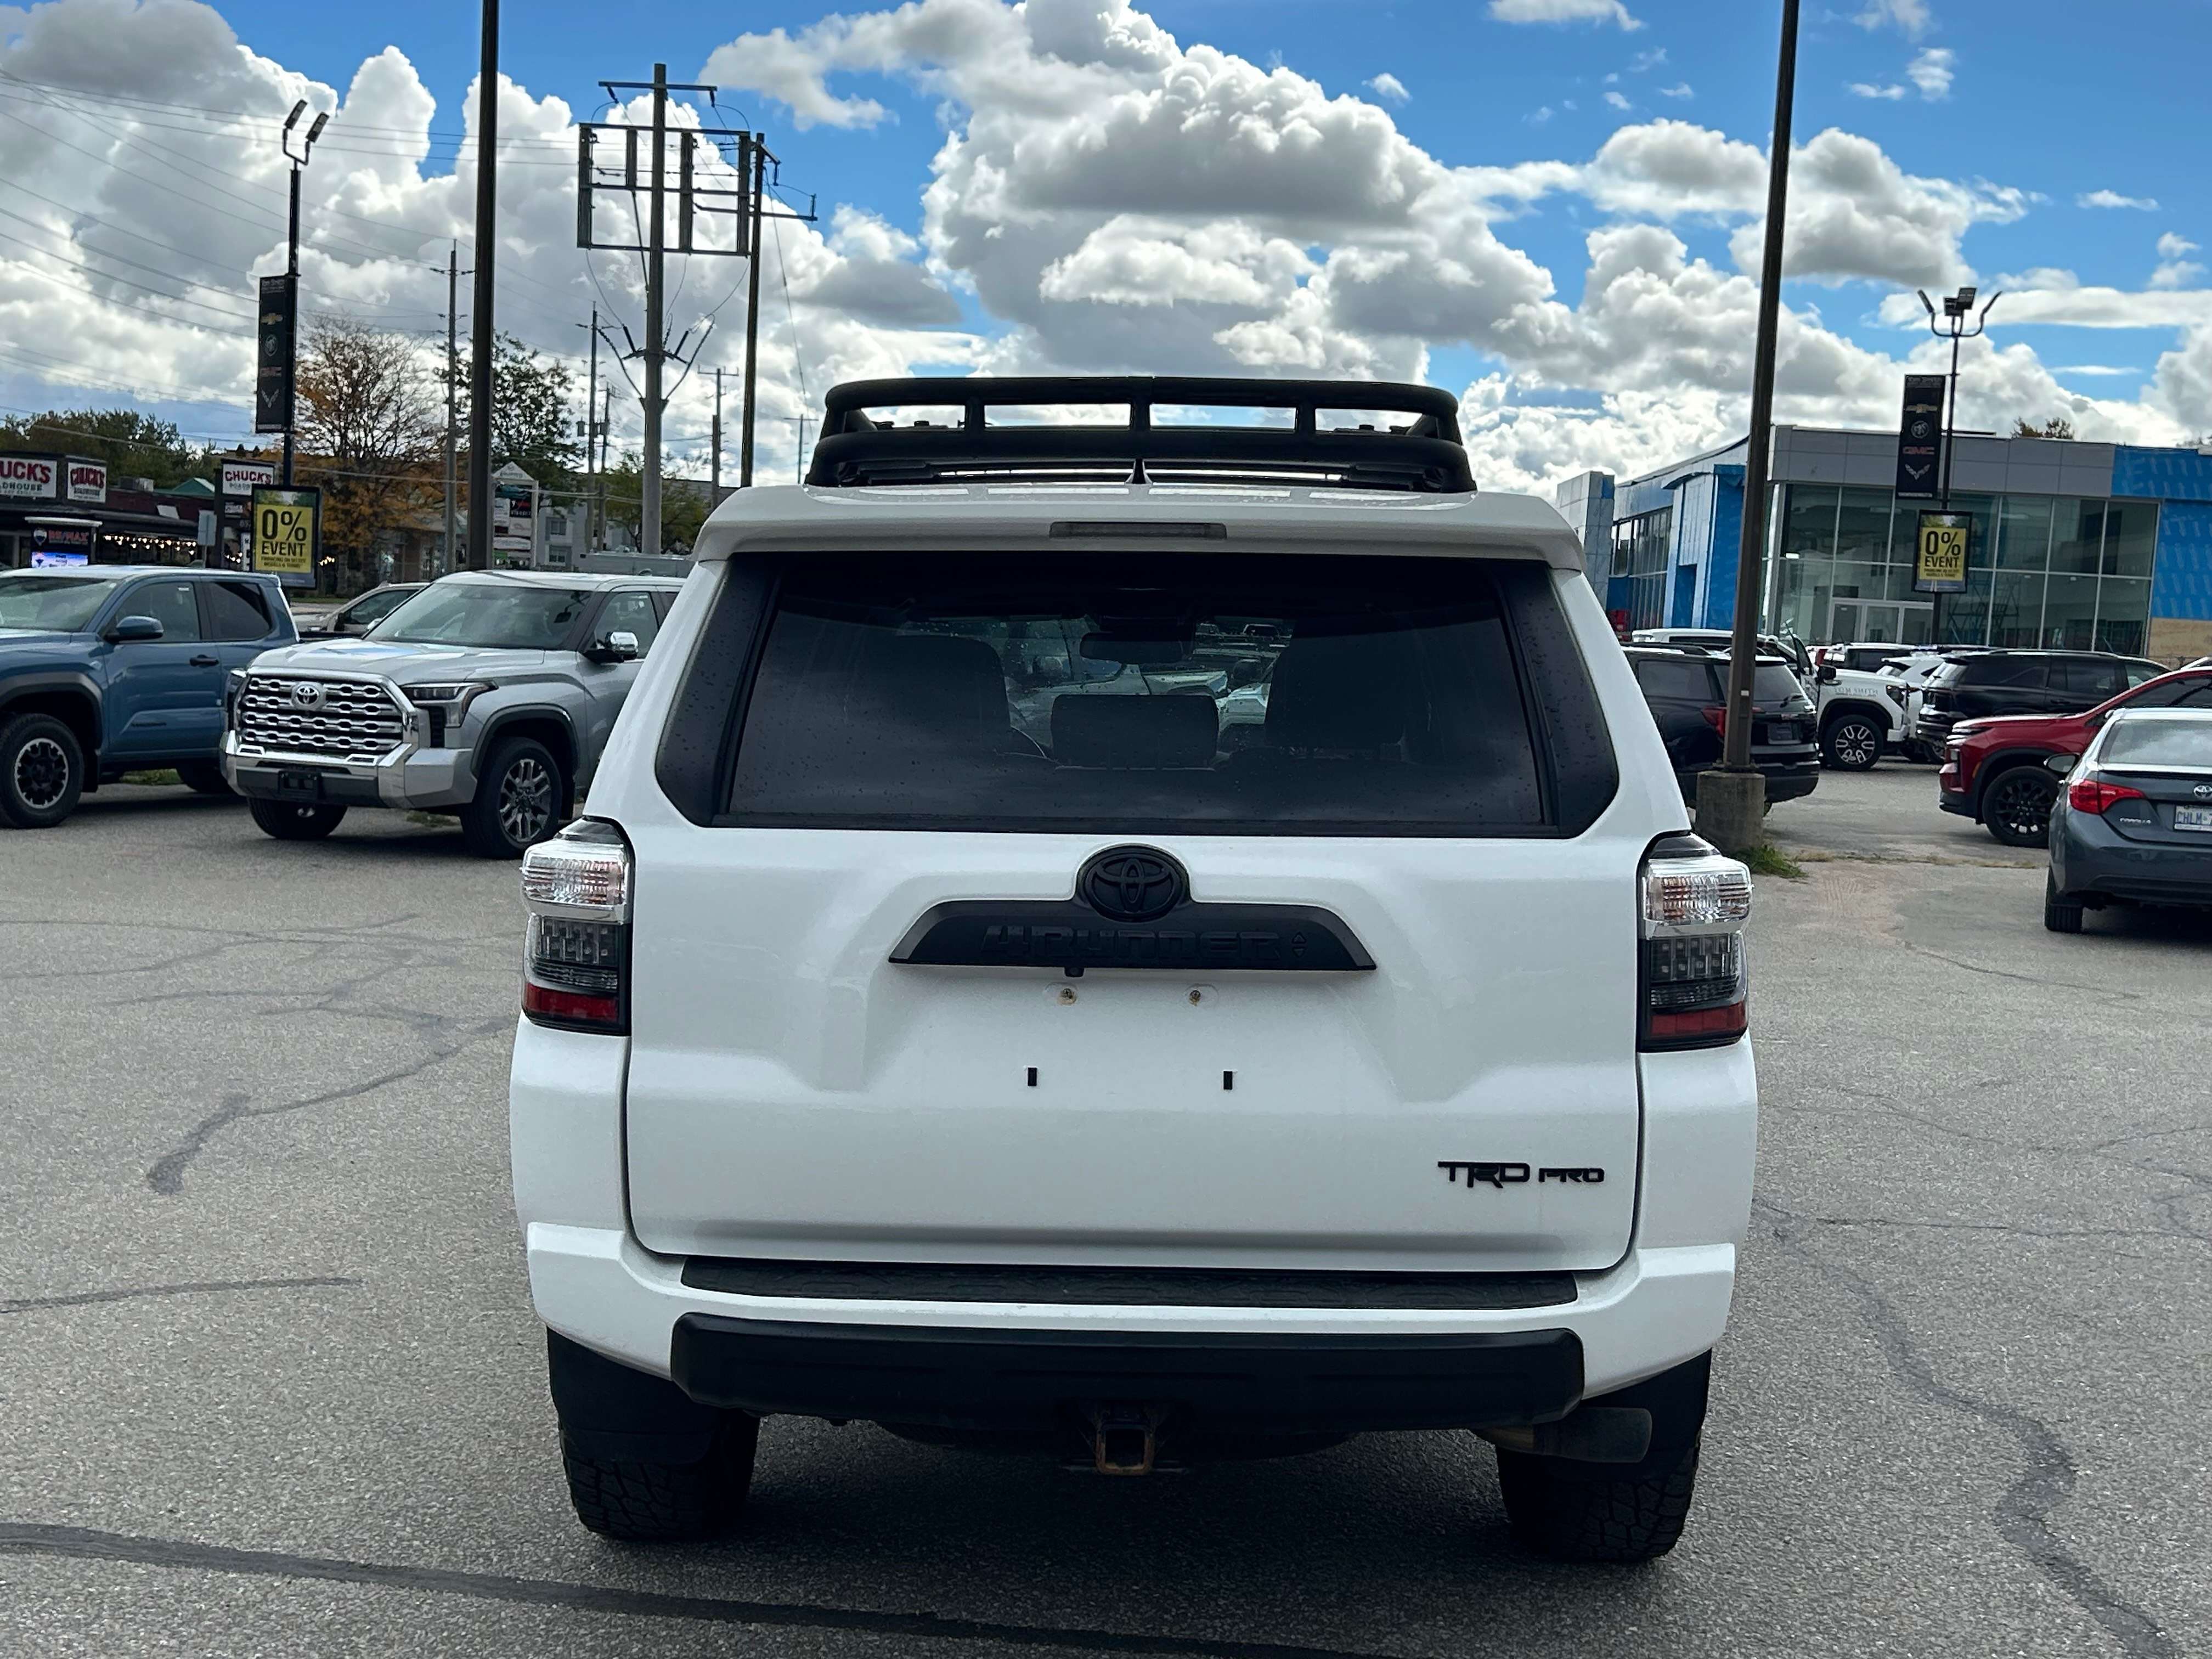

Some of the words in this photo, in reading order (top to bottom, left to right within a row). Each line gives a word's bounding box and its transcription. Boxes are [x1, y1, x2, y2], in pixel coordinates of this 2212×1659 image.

[225, 471, 272, 484] CHUCK'S
[0, 482, 43, 491] DHOUSE
[262, 509, 307, 541] 0%
[261, 540, 306, 557] EVENT
[1926, 531, 1961, 556] 0%
[1925, 556, 1959, 568] EVENT
[1437, 1161, 1531, 1188] TRD
[1538, 1167, 1605, 1183] PRO
